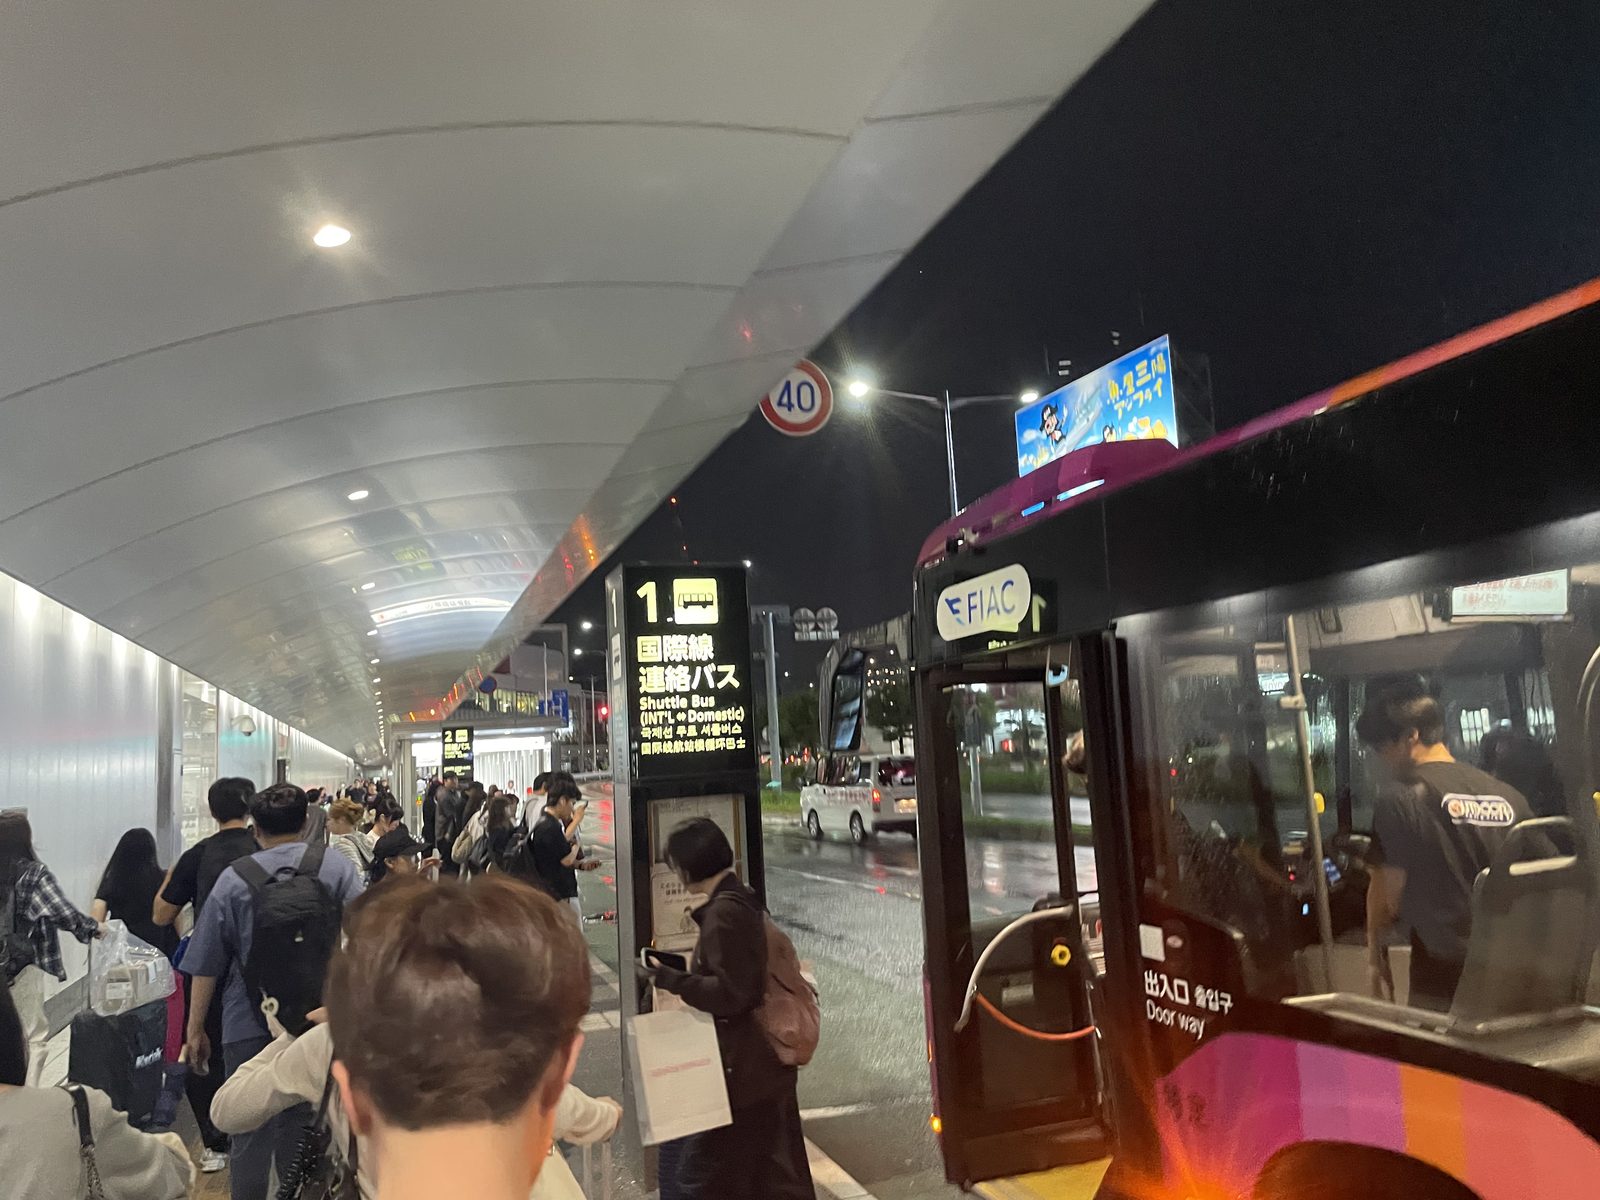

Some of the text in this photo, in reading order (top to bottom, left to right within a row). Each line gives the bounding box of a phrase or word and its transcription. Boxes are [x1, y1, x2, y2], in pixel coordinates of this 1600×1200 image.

[776, 380, 816, 413] 40
[636, 581, 658, 623] 1
[967, 579, 1016, 624] FIAC
[636, 633, 715, 663] 国際線
[638, 662, 741, 695] 連絡バス
[639, 694, 716, 711] Shuttle Bus
[687, 705, 746, 723] Domestic)
[444, 730, 453, 742] 2
[1144, 969, 1190, 1006] 出入口
[1146, 998, 1206, 1041] Door way
